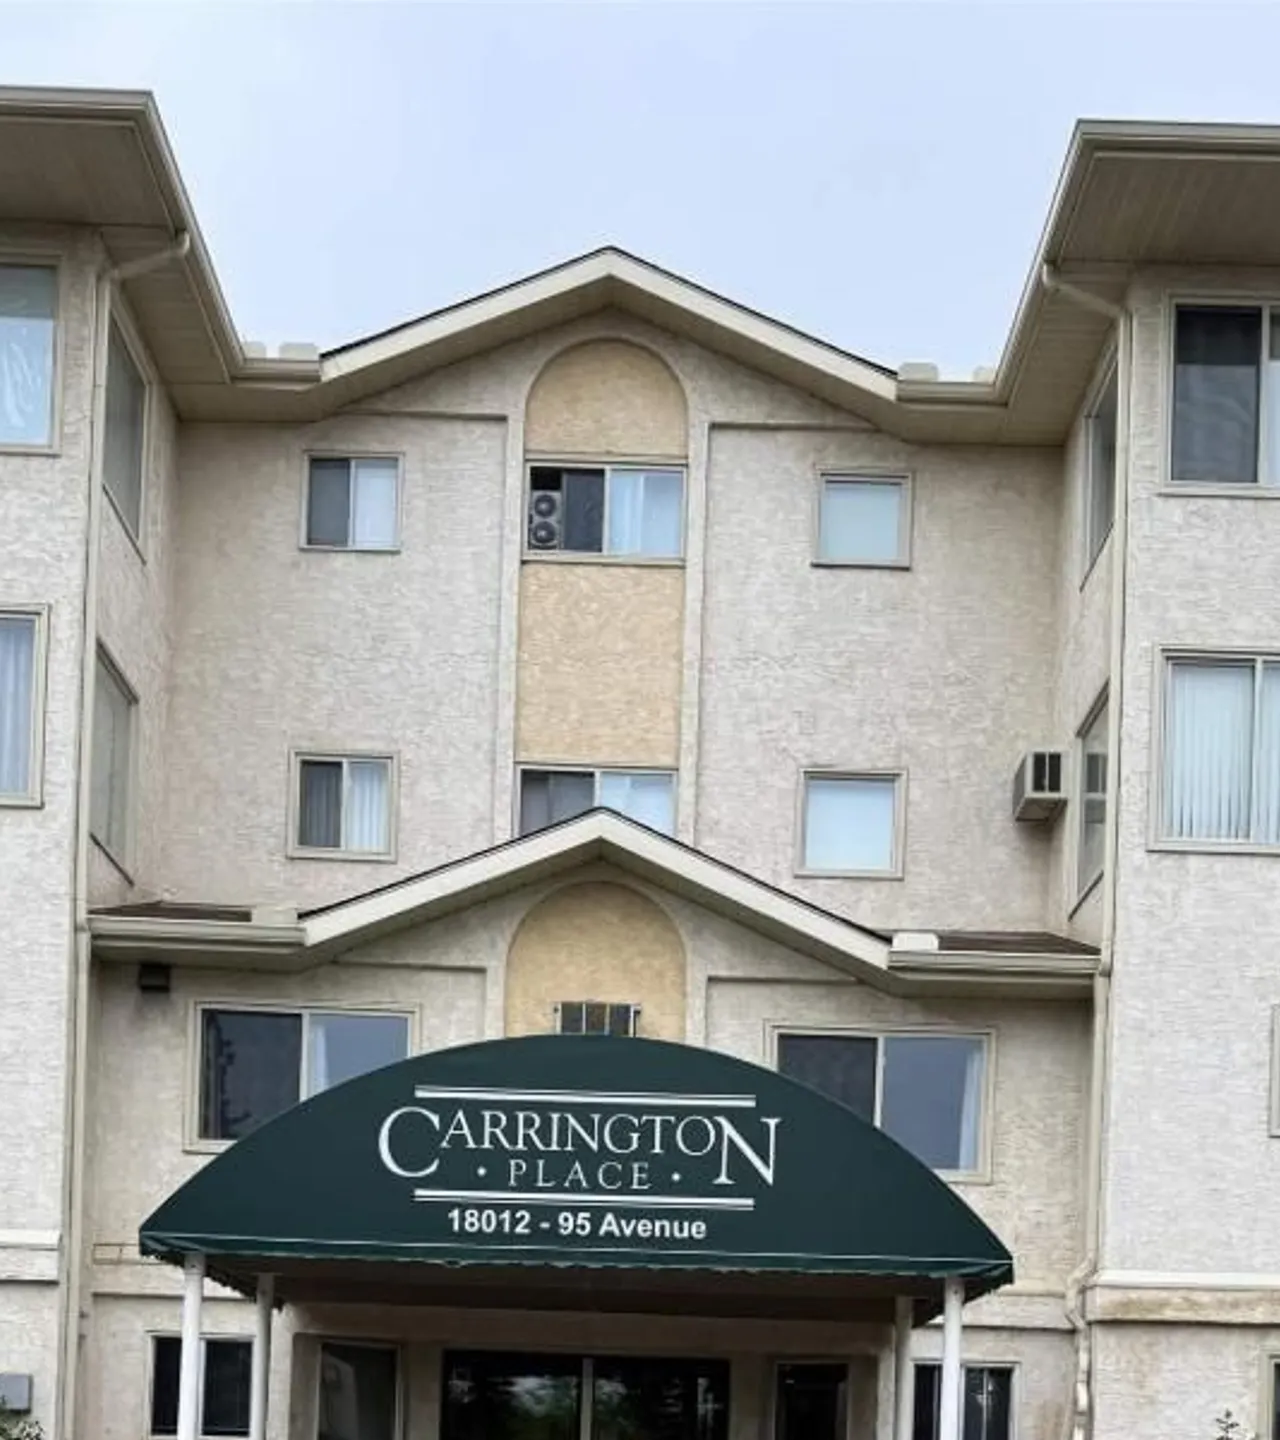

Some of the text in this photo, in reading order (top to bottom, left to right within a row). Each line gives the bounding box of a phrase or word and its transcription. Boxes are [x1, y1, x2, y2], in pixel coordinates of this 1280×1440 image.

[378, 1105, 782, 1186] CARRINGTON
[508, 1159, 651, 1190] PLACE
[447, 1207, 531, 1235] 18012
[557, 1211, 592, 1237] 95
[598, 1212, 707, 1240] Avenue
